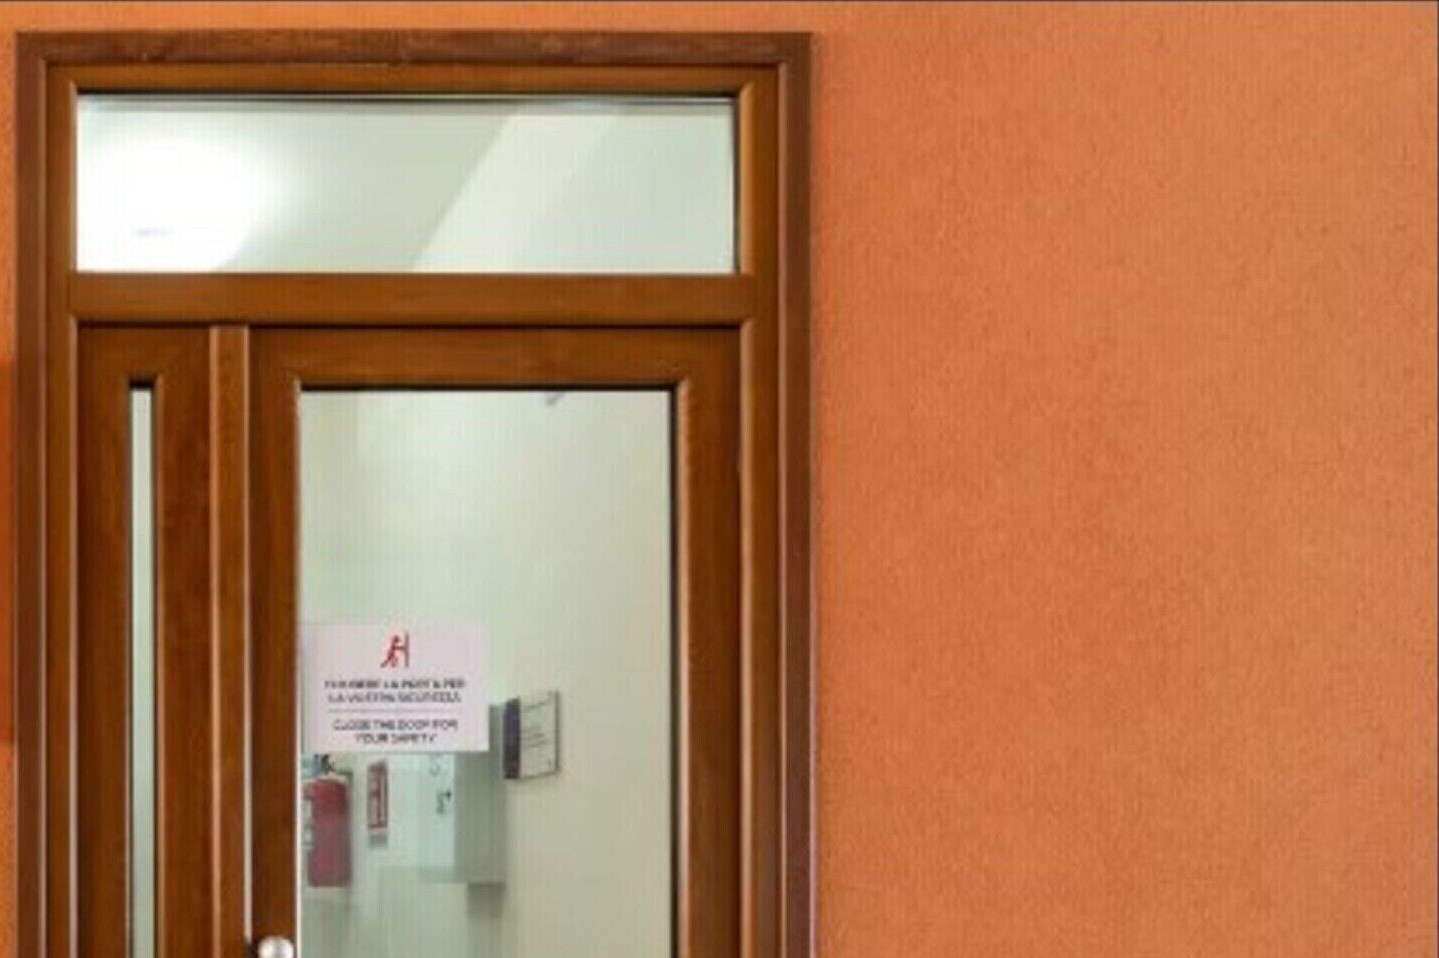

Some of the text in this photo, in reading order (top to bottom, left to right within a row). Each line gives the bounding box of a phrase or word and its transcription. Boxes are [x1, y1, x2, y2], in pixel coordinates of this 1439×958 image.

[374, 718, 395, 731] THE
[397, 718, 430, 731] DOOR
[432, 718, 458, 731] FOR
